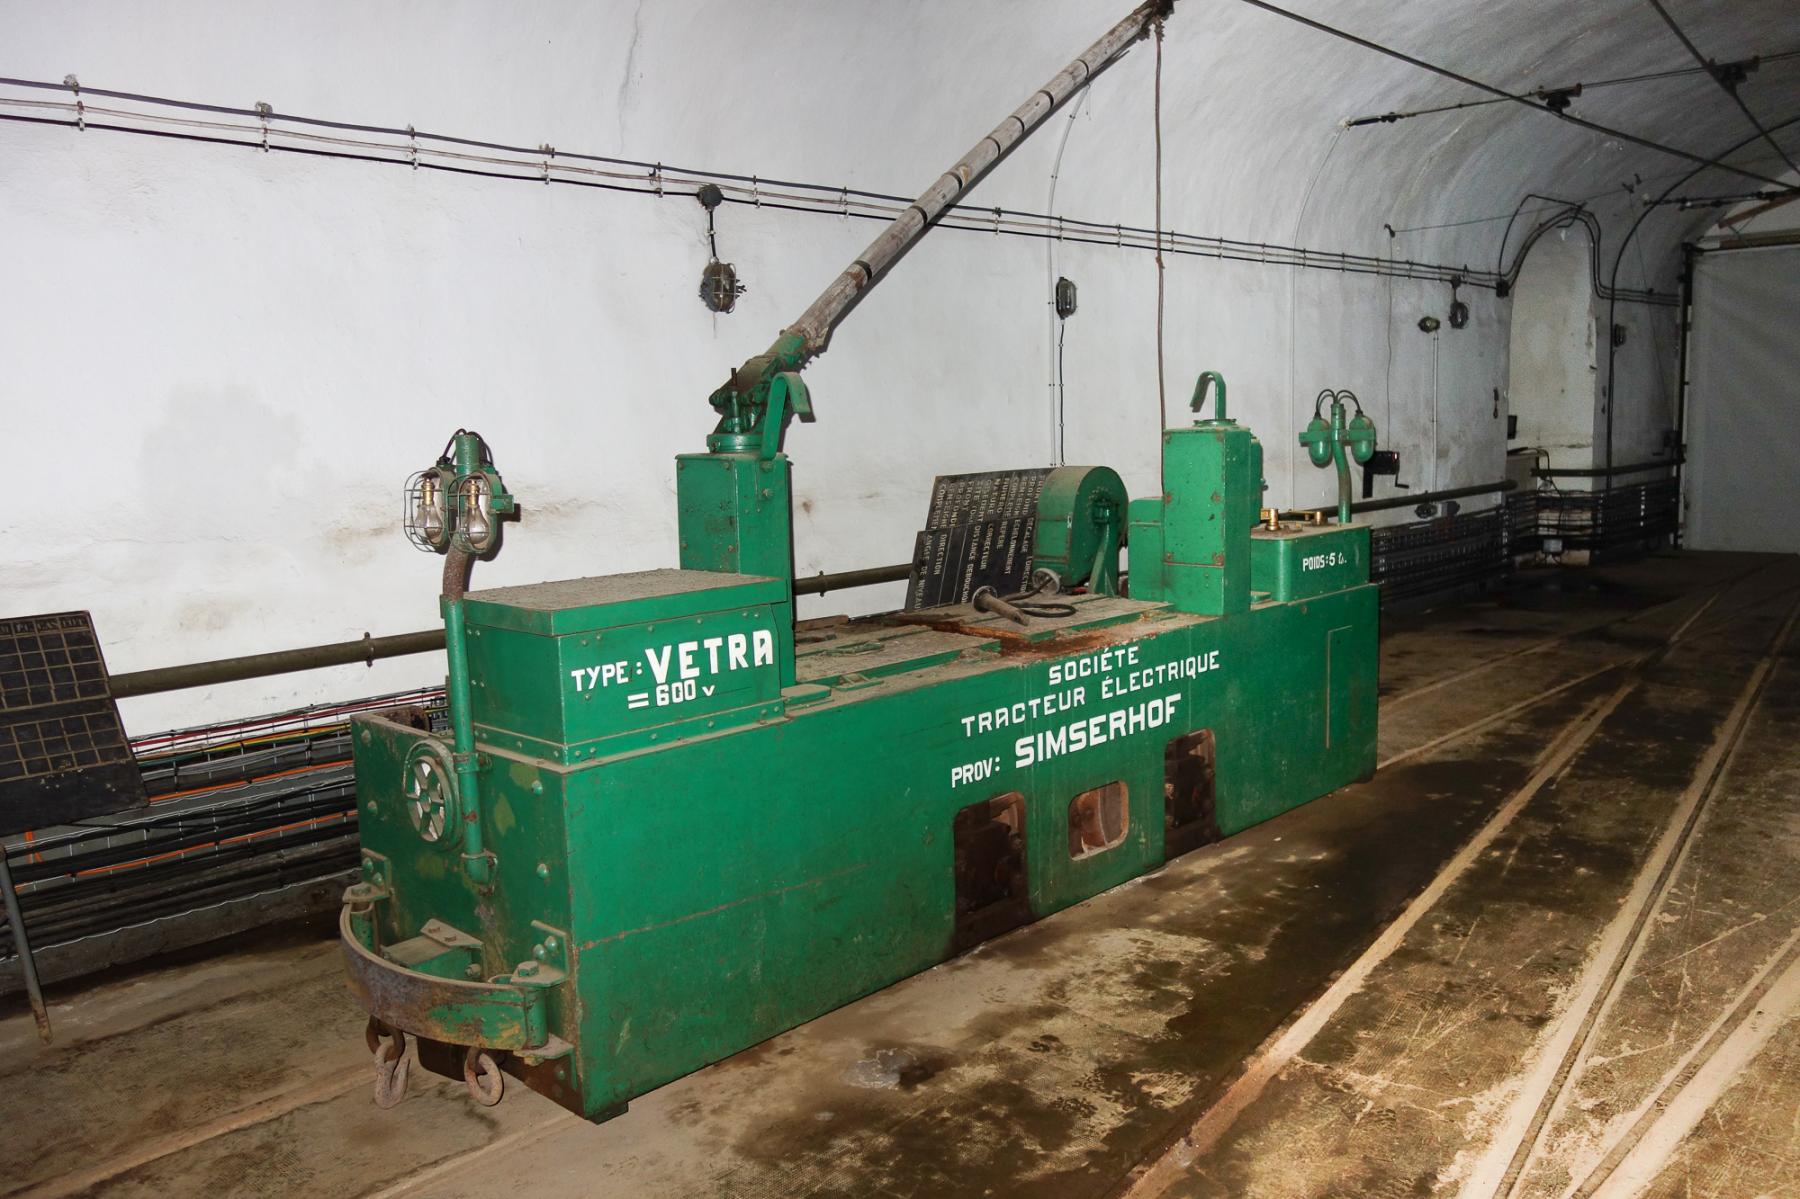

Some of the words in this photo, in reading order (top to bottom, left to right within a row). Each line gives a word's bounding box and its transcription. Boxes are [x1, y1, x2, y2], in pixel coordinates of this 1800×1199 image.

[644, 629, 774, 684] VETRA
[961, 686, 1086, 737] TRACTEUR
[1101, 650, 1220, 700] ÉLECTRIQUE
[951, 756, 1001, 788] PROV:
[1015, 693, 1182, 769] SIMSERHOF
